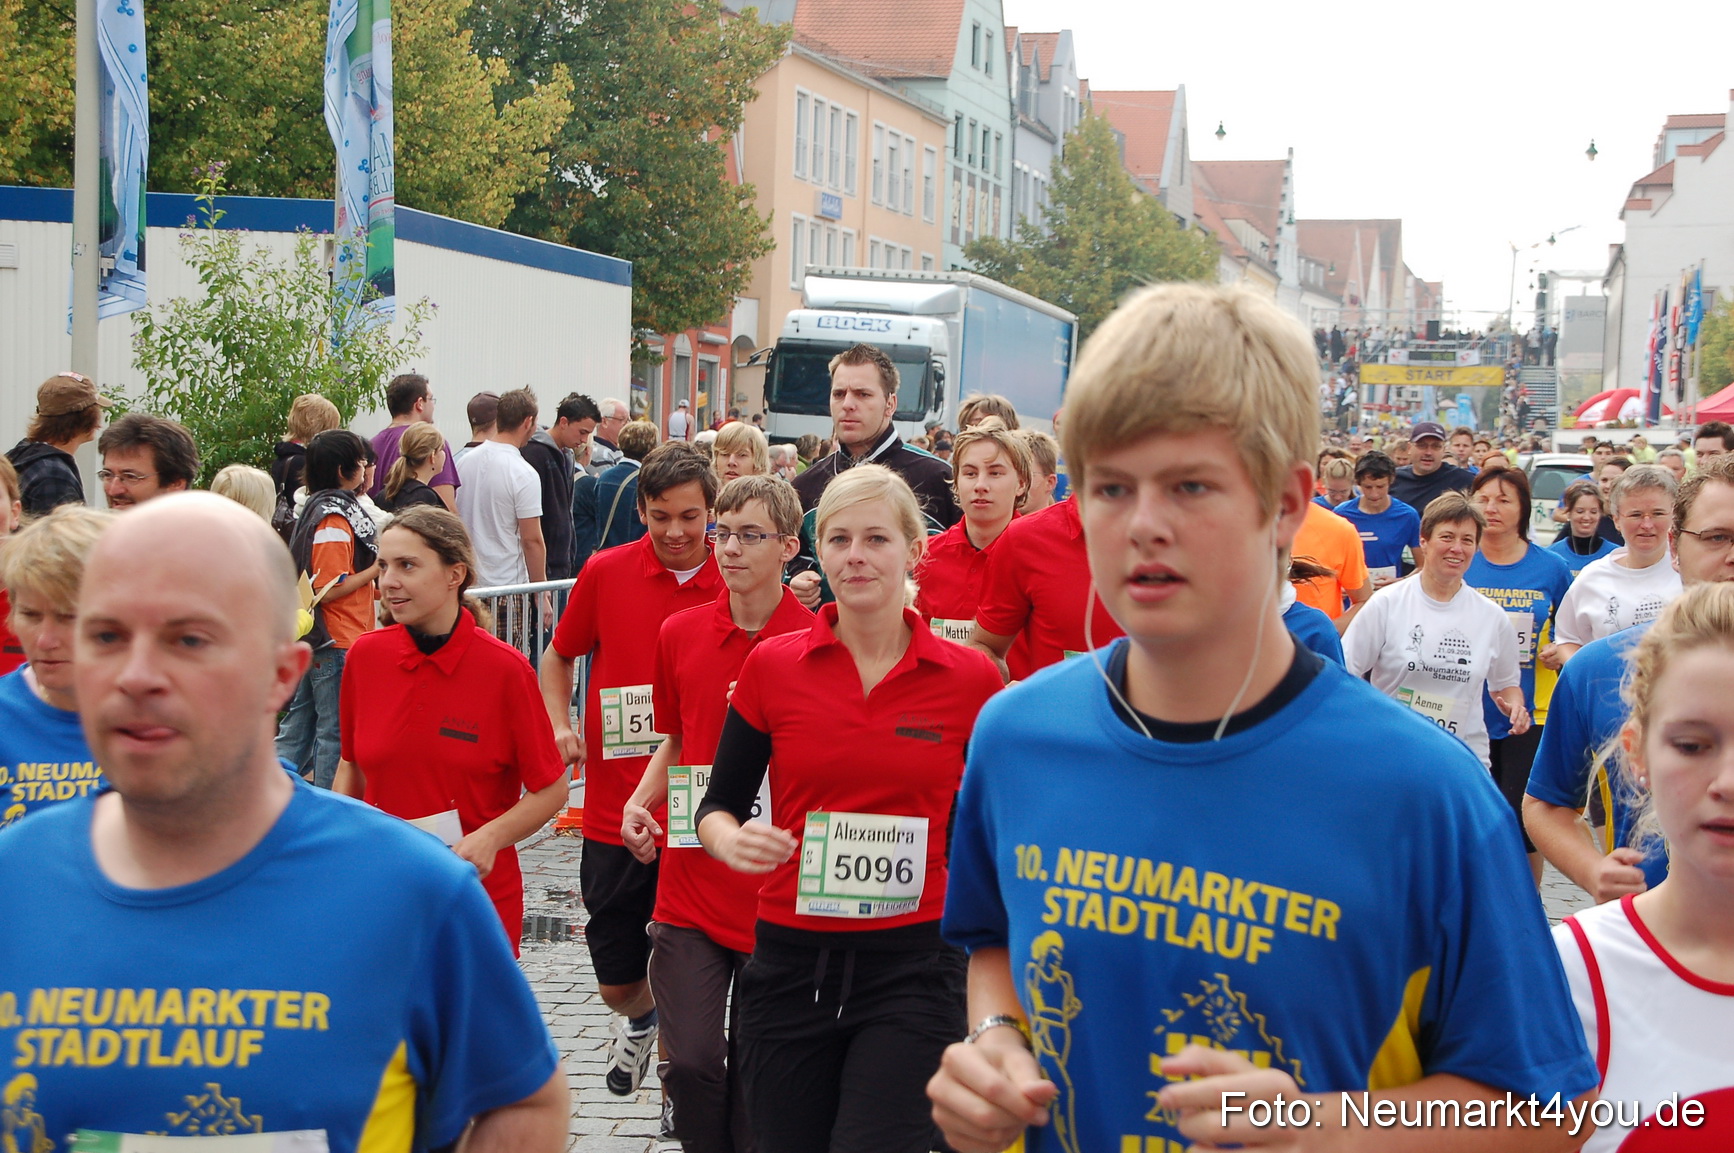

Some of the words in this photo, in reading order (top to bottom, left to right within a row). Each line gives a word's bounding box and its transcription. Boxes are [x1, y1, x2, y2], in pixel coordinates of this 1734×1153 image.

[818, 316, 892, 332] BOCK
[1406, 368, 1455, 382] START
[1422, 664, 1471, 676] Neumarkter
[1432, 673, 1471, 683] Stadtlauf
[1414, 695, 1444, 711] Aenne
[606, 715, 612, 725] S
[673, 796, 680, 809] S
[834, 821, 914, 844] Alexandra
[834, 853, 914, 885] 5096
[1015, 844, 1048, 882] 10.
[1053, 846, 1342, 941] NEUMARKTER
[1041, 885, 1275, 964] STADTLAUF
[27, 987, 331, 1031] NEUMARKTER
[13, 1028, 265, 1067] STADTLAUF
